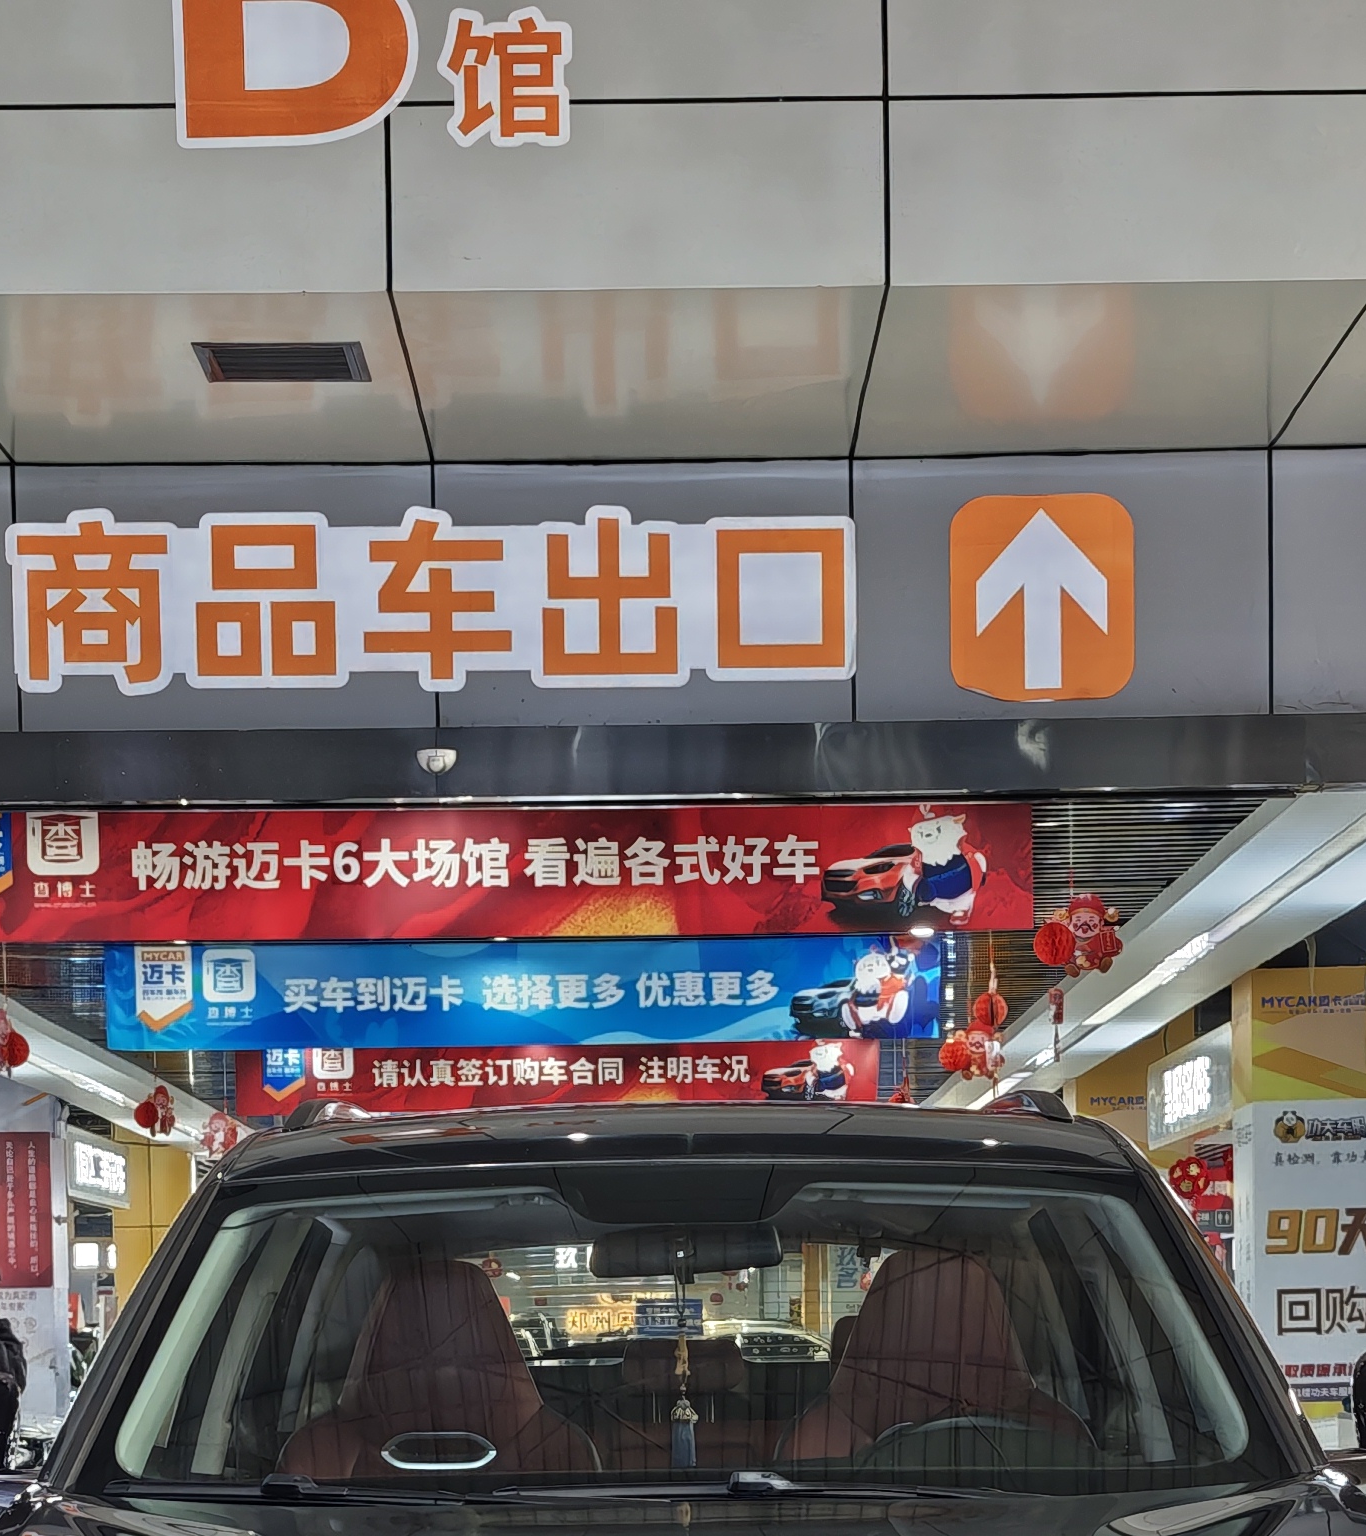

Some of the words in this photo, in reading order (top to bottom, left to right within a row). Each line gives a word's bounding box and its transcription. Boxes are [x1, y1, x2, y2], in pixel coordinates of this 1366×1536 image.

[15, 517, 847, 684] 商品车出口
[130, 839, 510, 891] 畅游迈卡6大场馆
[524, 835, 820, 887] 看遍各式好车
[142, 964, 185, 986] 迈卡
[143, 952, 184, 961] MYCAR
[283, 975, 464, 1014] 买车到迈卡
[481, 973, 625, 1011] 选择更多
[636, 970, 780, 1009] 优惠更多
[372, 1059, 623, 1088] 请认真签订购车合同
[638, 1056, 750, 1084] 注明车况
